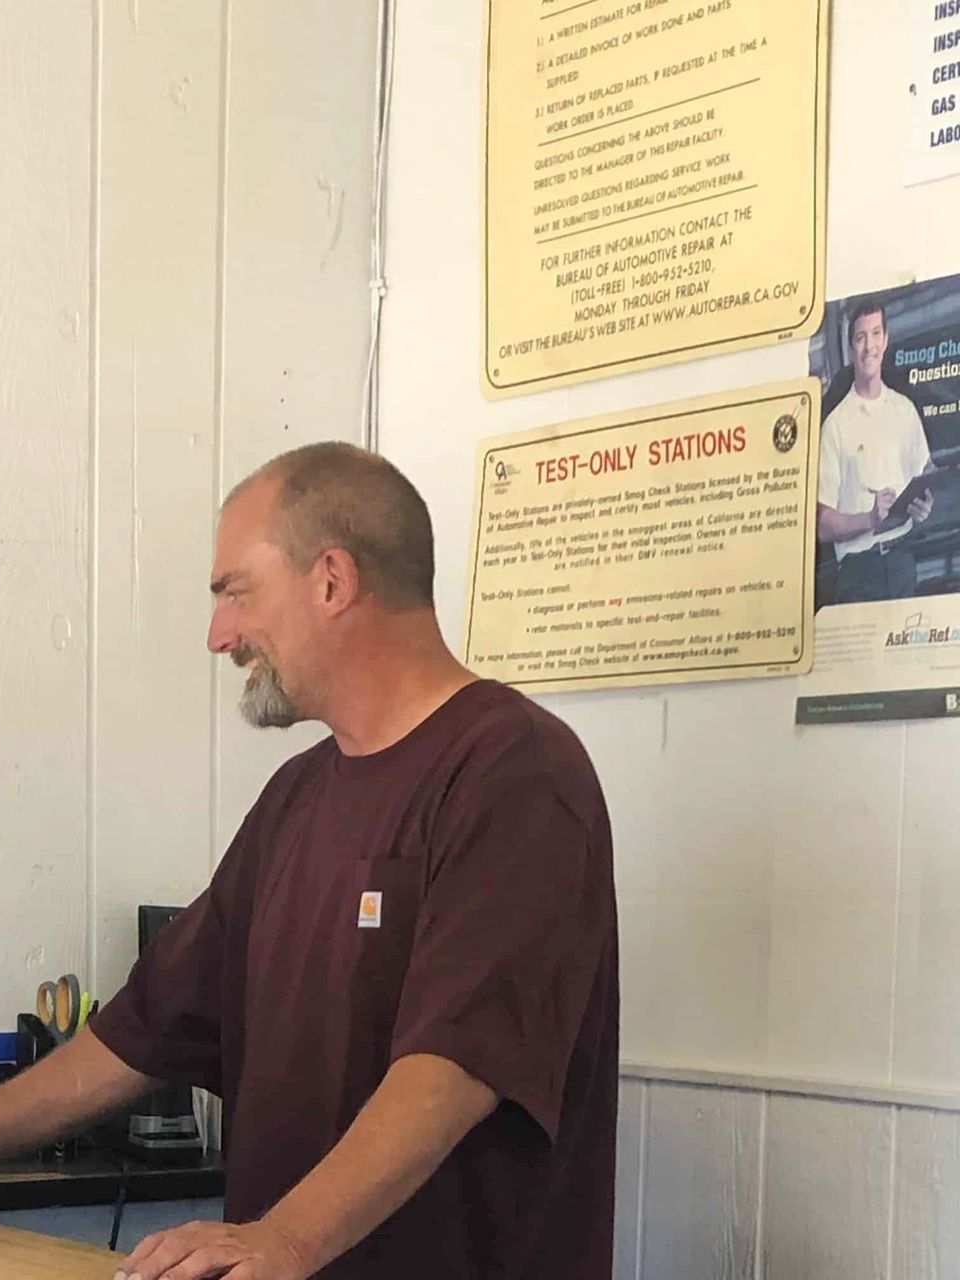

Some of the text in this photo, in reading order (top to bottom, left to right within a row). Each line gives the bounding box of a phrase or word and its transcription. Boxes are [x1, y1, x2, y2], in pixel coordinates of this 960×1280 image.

[931, 94, 956, 116] GAS
[541, 207, 752, 270] FOR FURTHER INFORMATION CONTACT THE
[556, 232, 733, 287] BUREAU OF AUTOMOTIVE REPAIR AT
[571, 279, 625, 304] (TOLL-FREE)
[575, 280, 709, 322] MONDAY THROUGH FRIDAY
[499, 344, 514, 359] OR
[514, 340, 533, 355] VISIT
[536, 336, 550, 349] THE
[551, 326, 595, 348] BUREAU'S
[597, 321, 617, 336] WEB
[619, 317, 638, 332] SITE
[639, 314, 649, 327] AT
[895, 345, 936, 366] Smog
[923, 403, 957, 416] We can
[535, 445, 637, 484] TEST-ONLY
[648, 426, 746, 465] STATIONS
